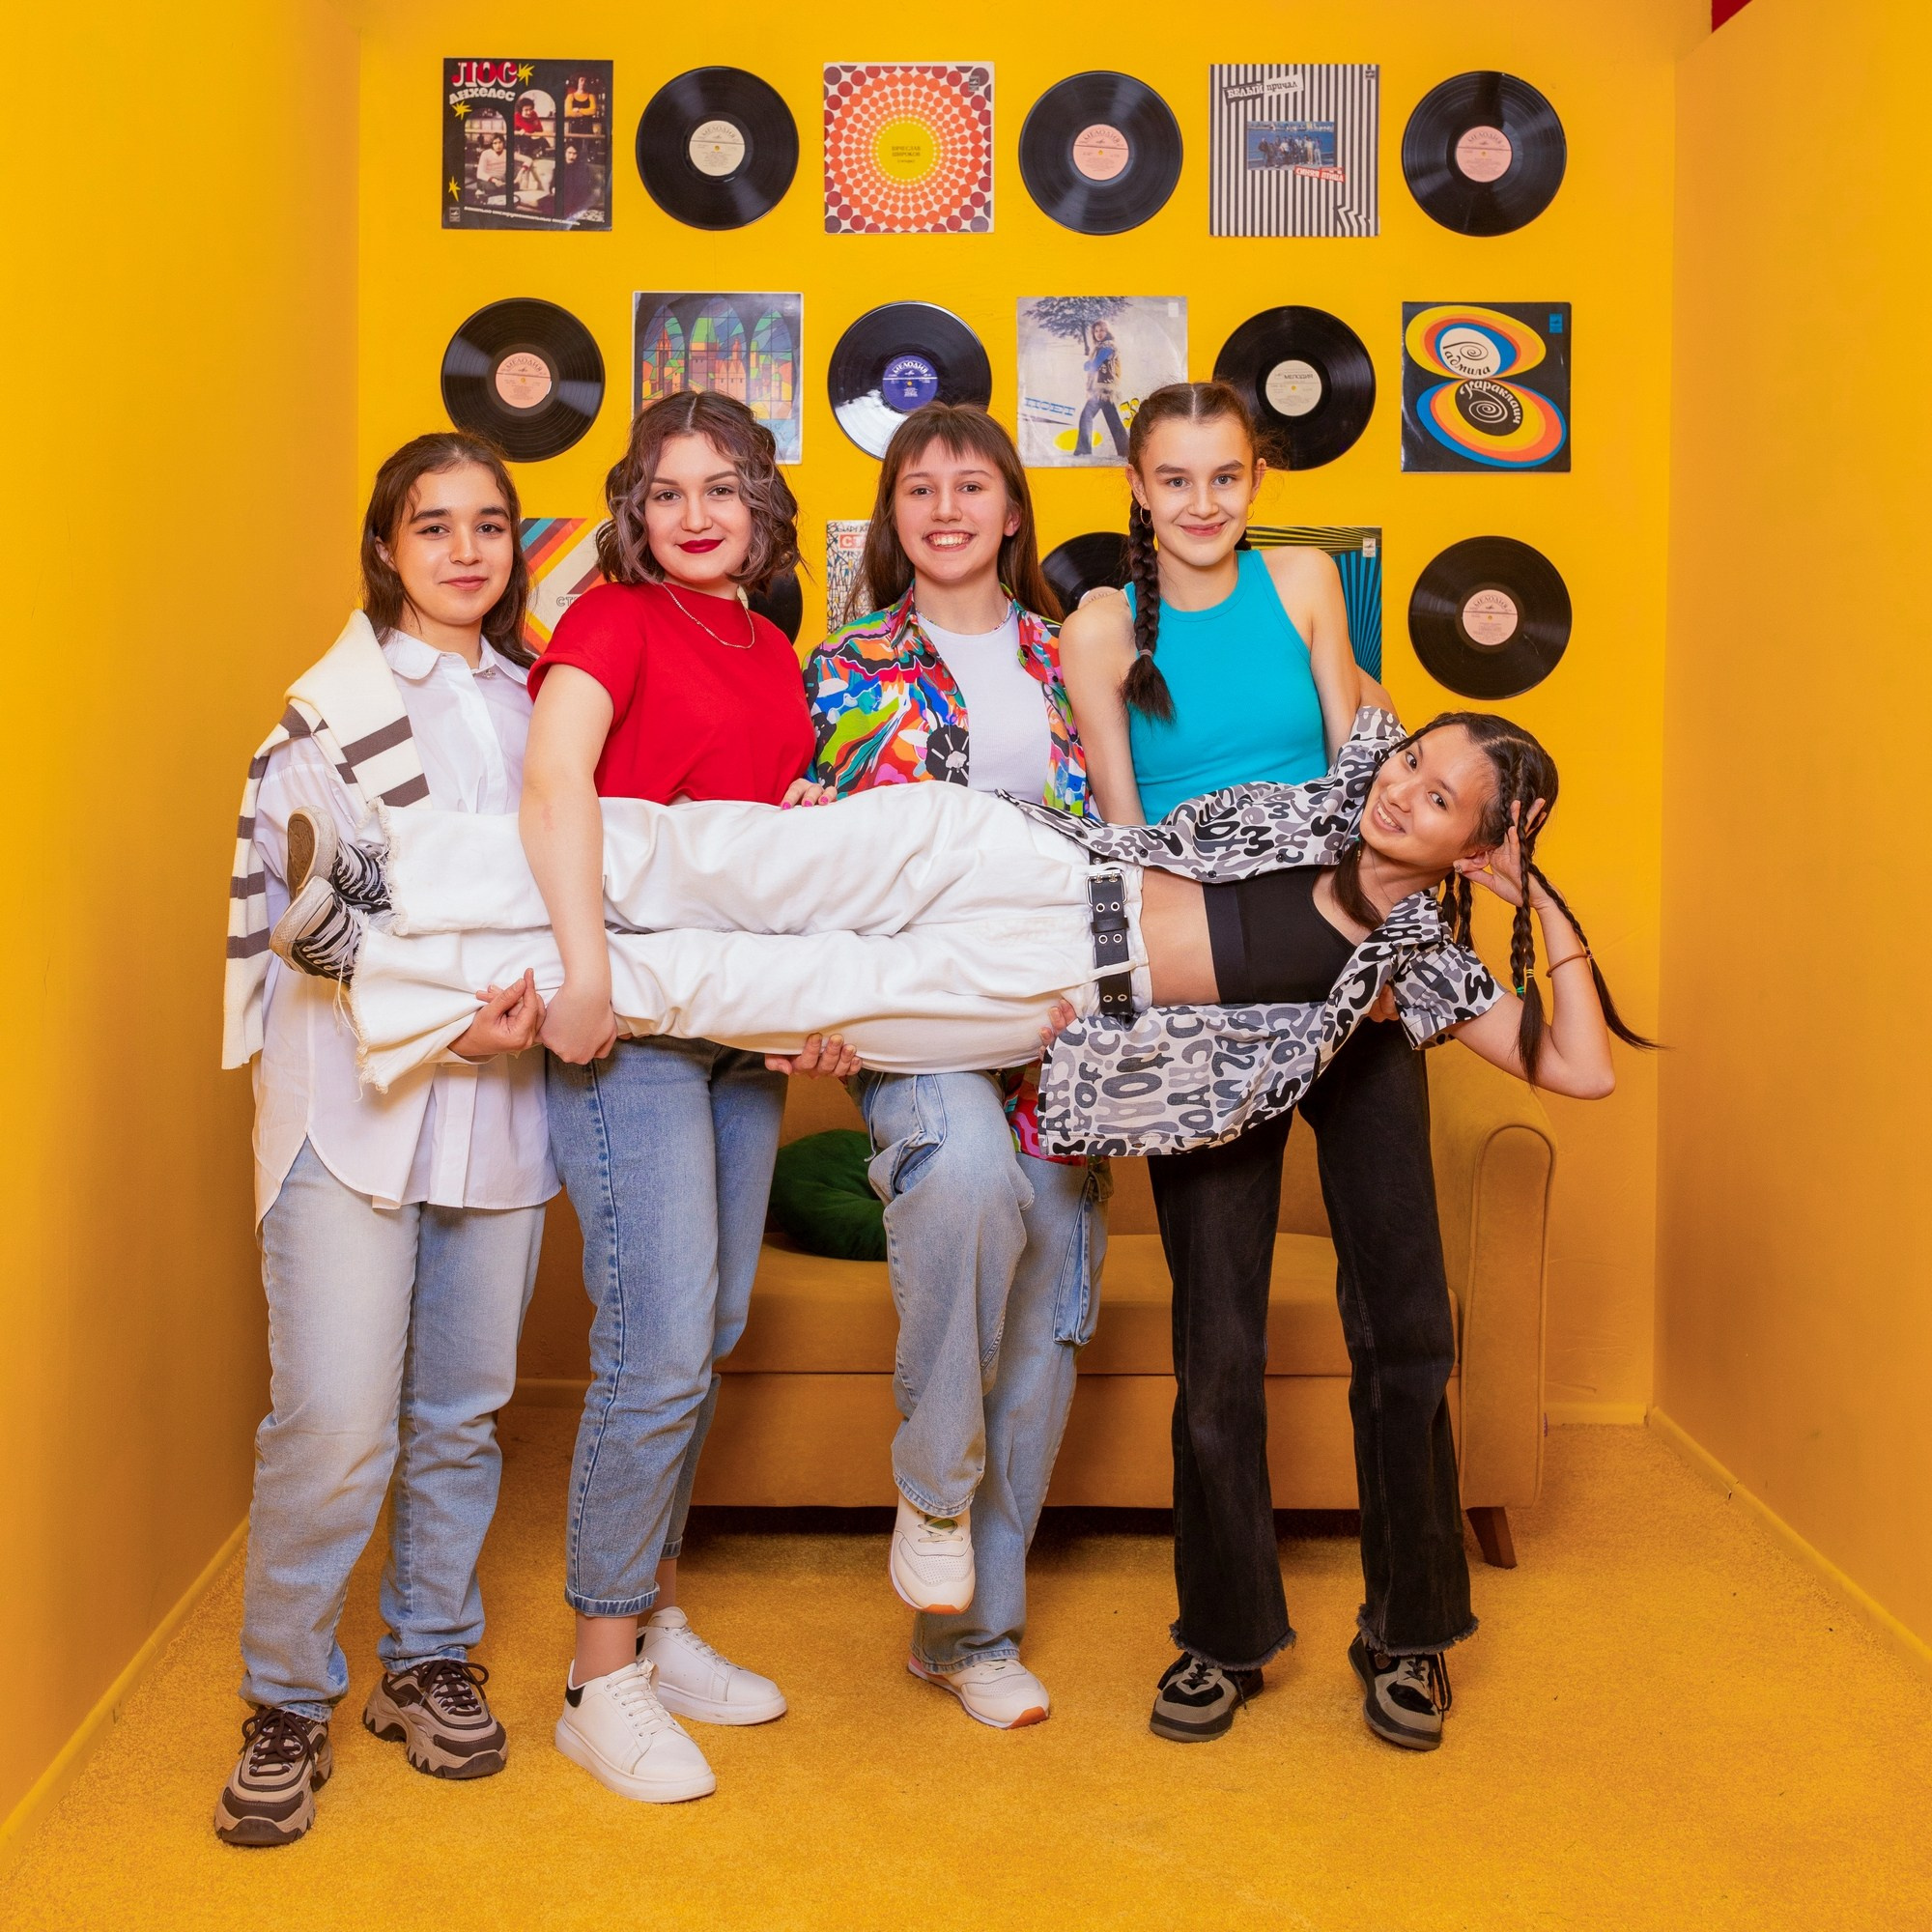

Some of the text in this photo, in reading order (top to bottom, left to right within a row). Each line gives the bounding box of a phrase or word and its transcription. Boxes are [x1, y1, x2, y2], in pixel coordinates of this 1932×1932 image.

[451, 61, 518, 88] ЛОС
[1227, 83, 1264, 99] БЕЛЫЙ
[892, 360, 929, 374] МЕЛОДИЯ
